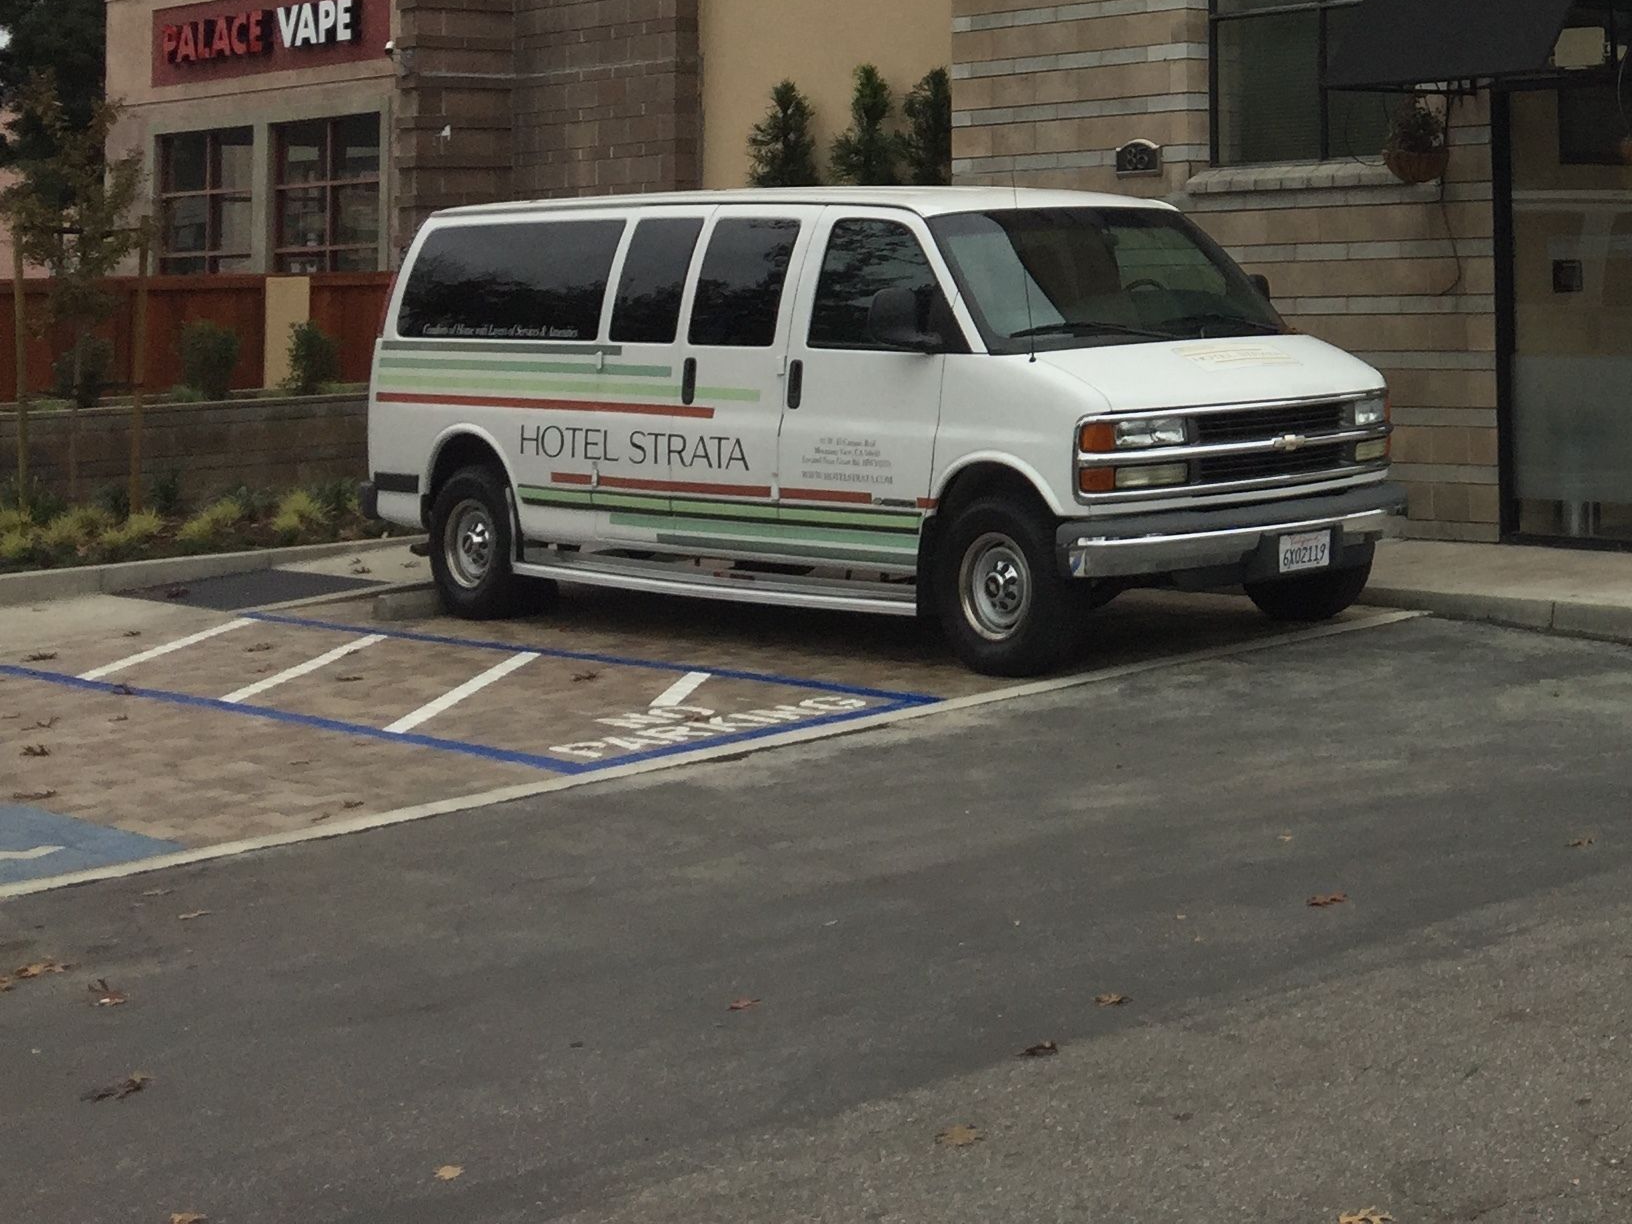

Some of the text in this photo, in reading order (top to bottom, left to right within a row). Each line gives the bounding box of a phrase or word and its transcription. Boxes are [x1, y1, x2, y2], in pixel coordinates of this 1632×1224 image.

[162, 10, 263, 63] PALACE
[520, 425, 750, 472] HOTEL STRATA
[1282, 542, 1327, 568] 6X02119
[549, 695, 868, 758] PARKING
[594, 705, 716, 727] NO
